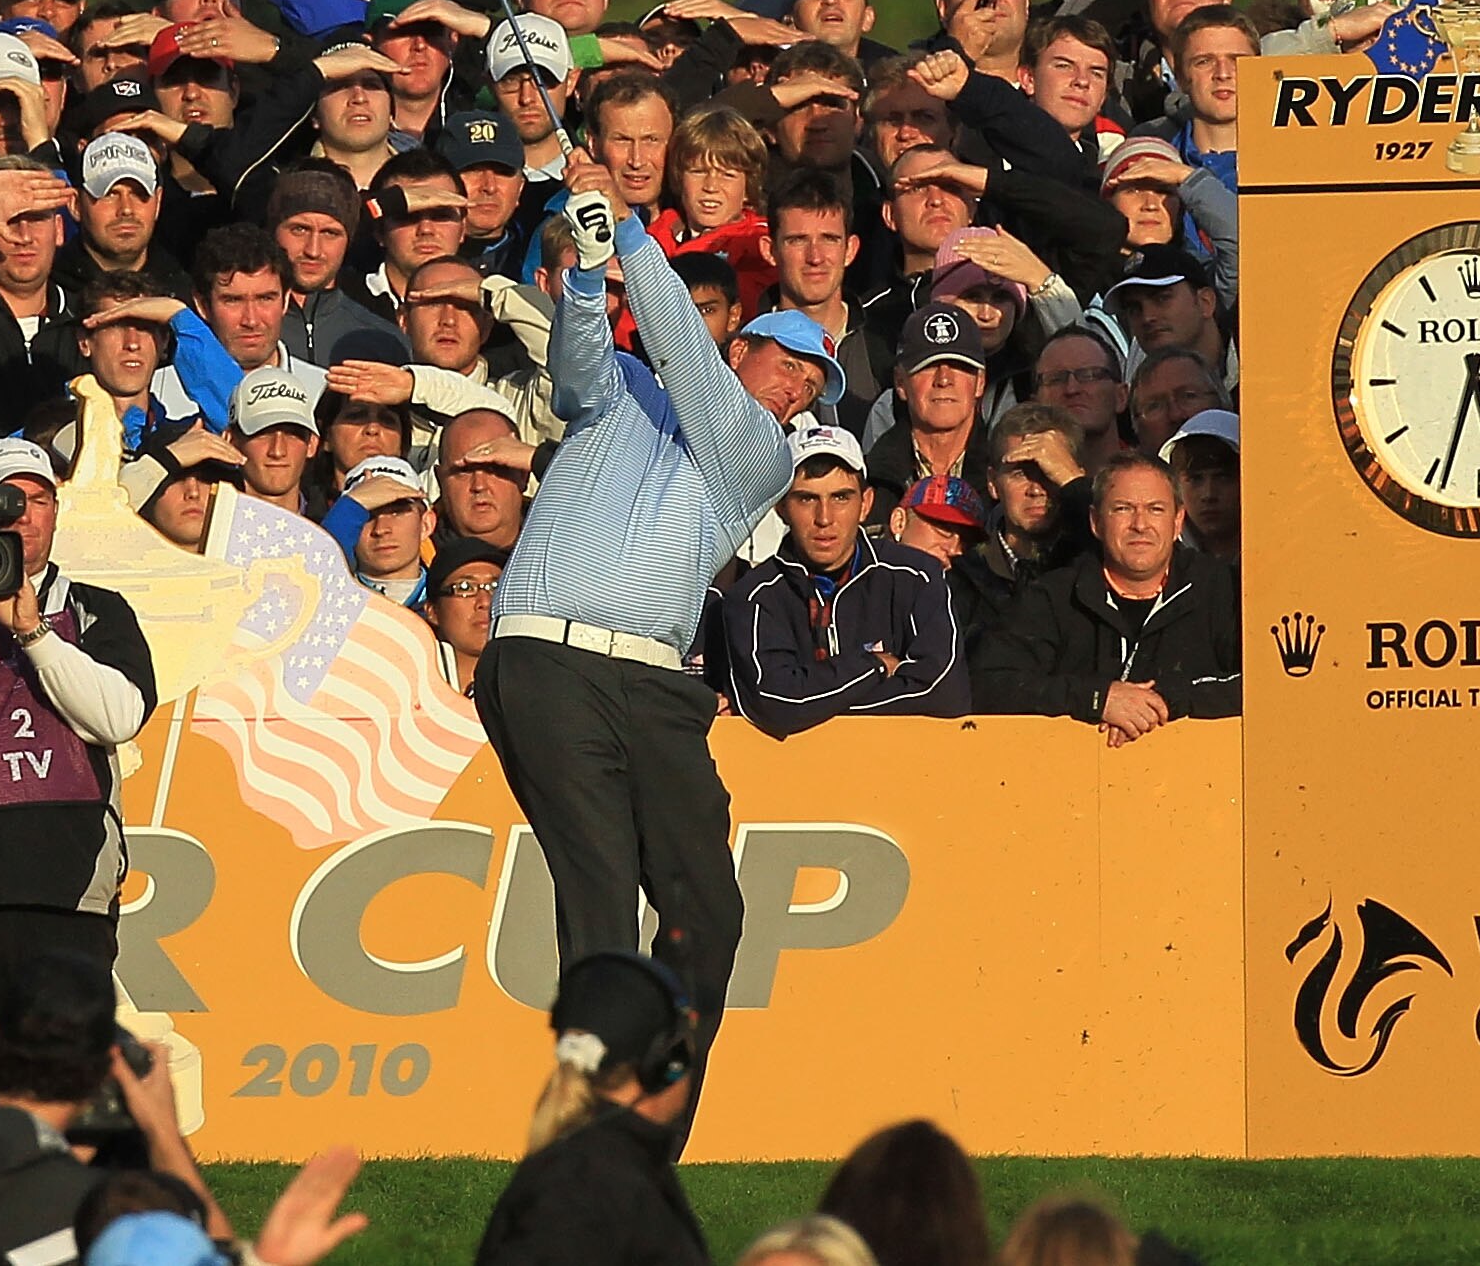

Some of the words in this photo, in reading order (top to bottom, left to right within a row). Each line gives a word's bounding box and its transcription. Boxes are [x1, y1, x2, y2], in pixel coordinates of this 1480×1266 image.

[470, 124, 495, 141] 20
[1374, 141, 1433, 161] 1927
[246, 381, 308, 405] Titleist
[1366, 689, 1462, 712] OFFICIAL
[10, 708, 35, 738] 2
[3, 749, 53, 781] TV
[228, 1043, 431, 1098] 2010
